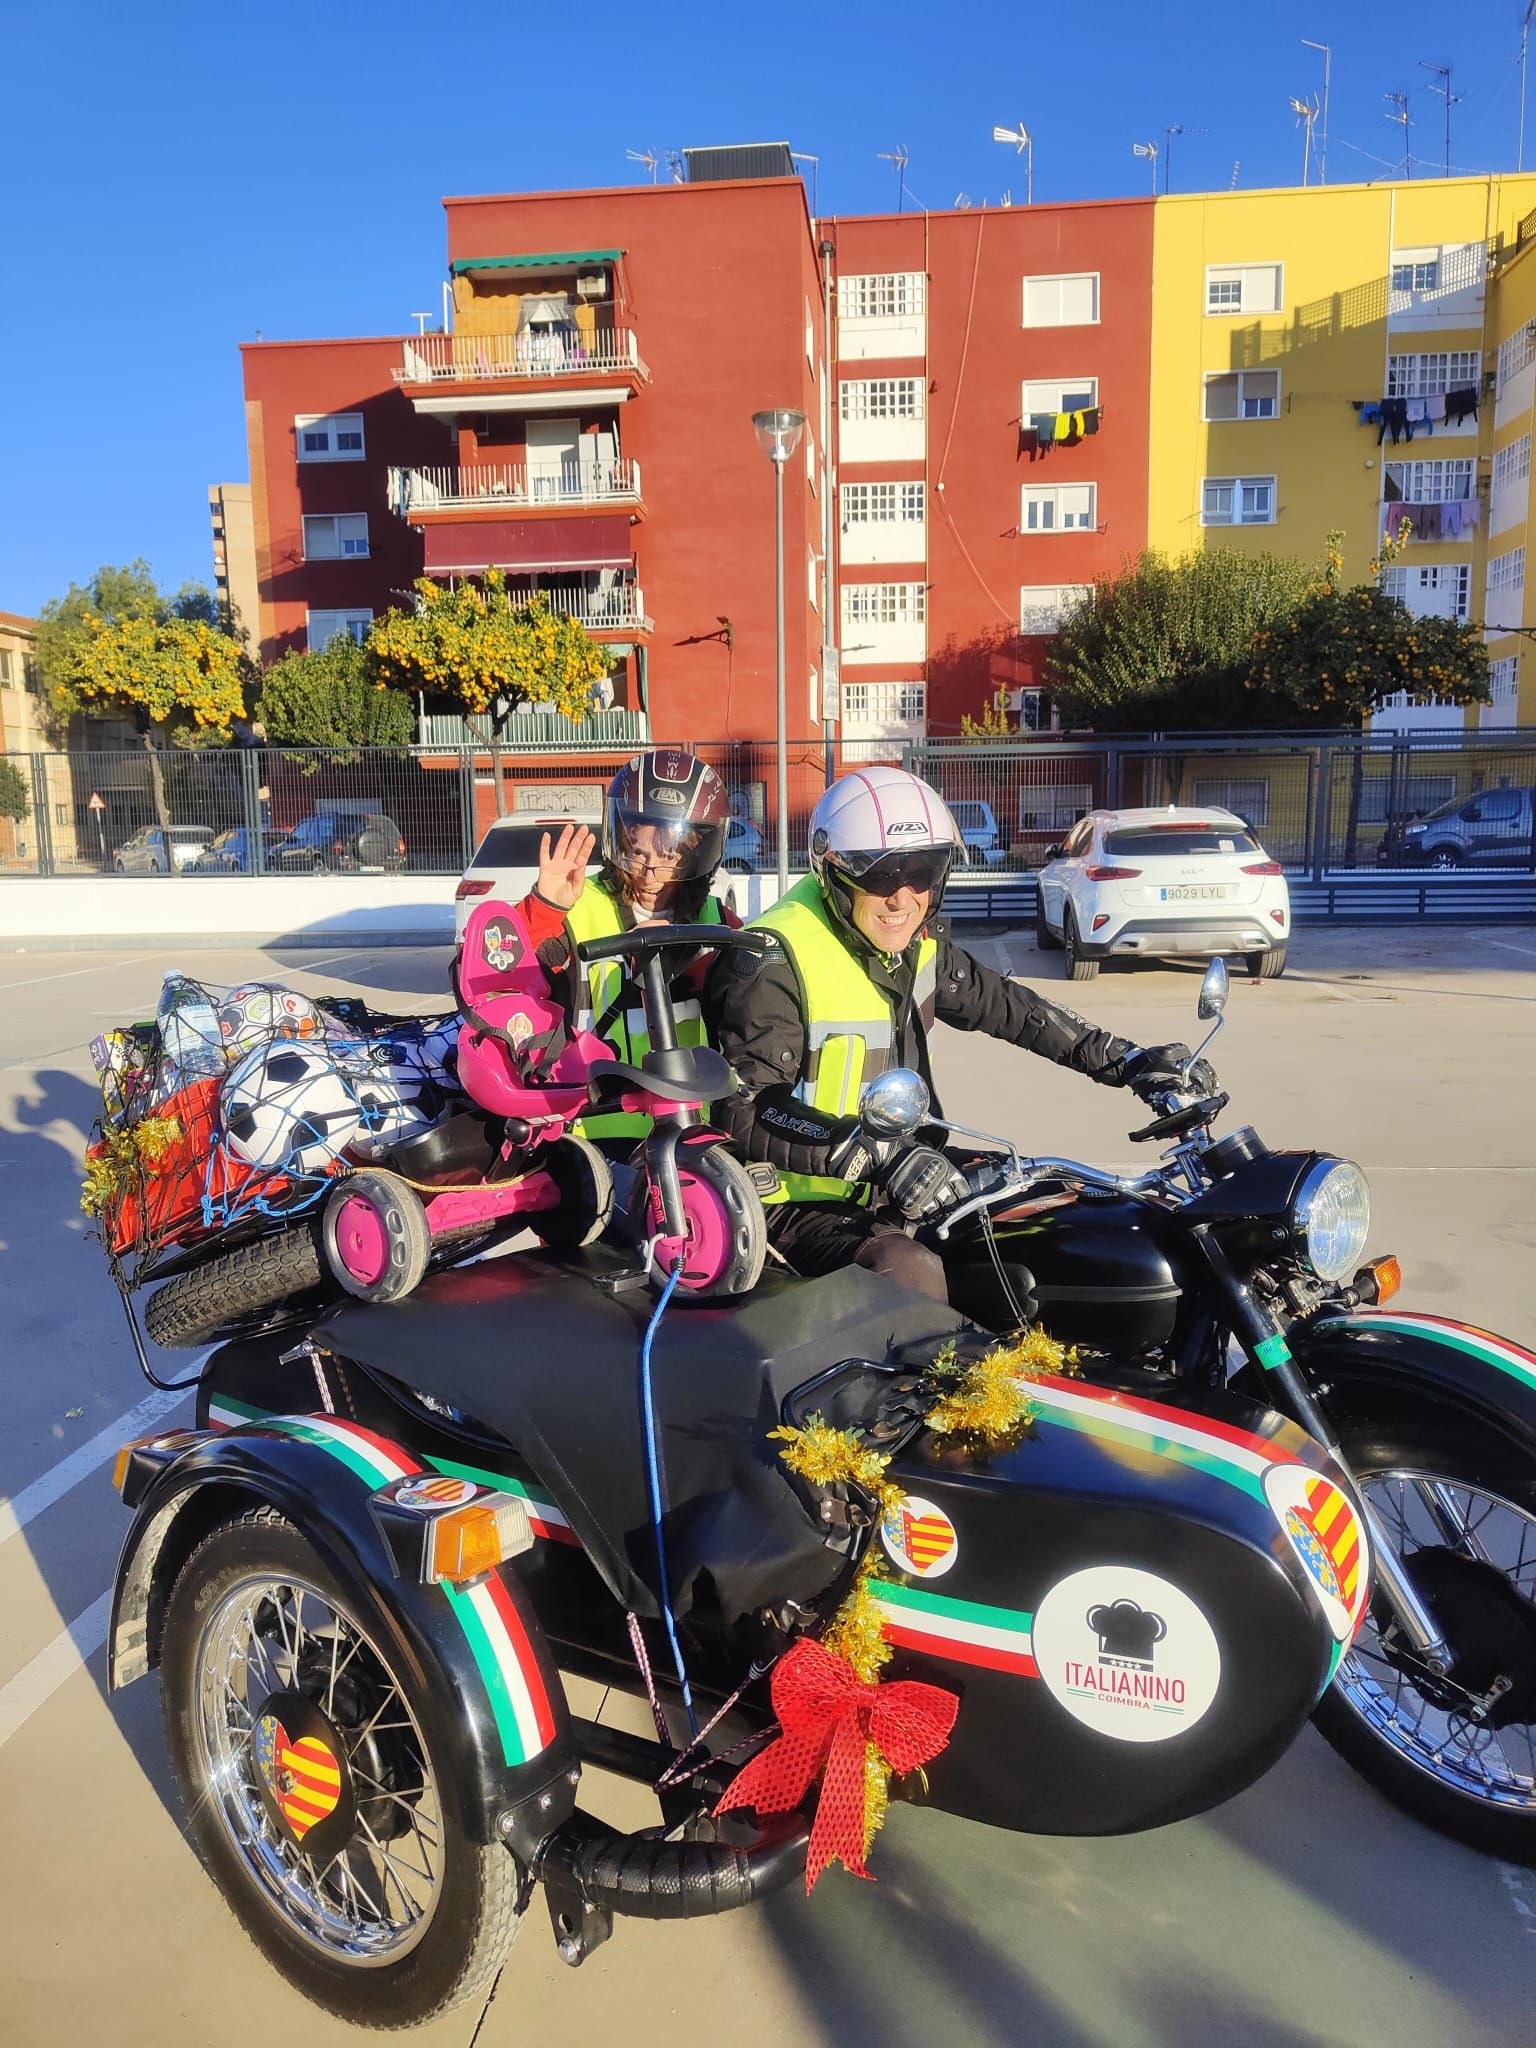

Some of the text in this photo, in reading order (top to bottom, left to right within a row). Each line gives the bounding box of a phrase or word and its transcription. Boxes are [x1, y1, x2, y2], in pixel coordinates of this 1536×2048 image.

[1168, 887, 1224, 899] 9029 LYL
[1065, 1661, 1185, 1704] ITALIANINO
[1098, 1693, 1151, 1710] COIMBRA
